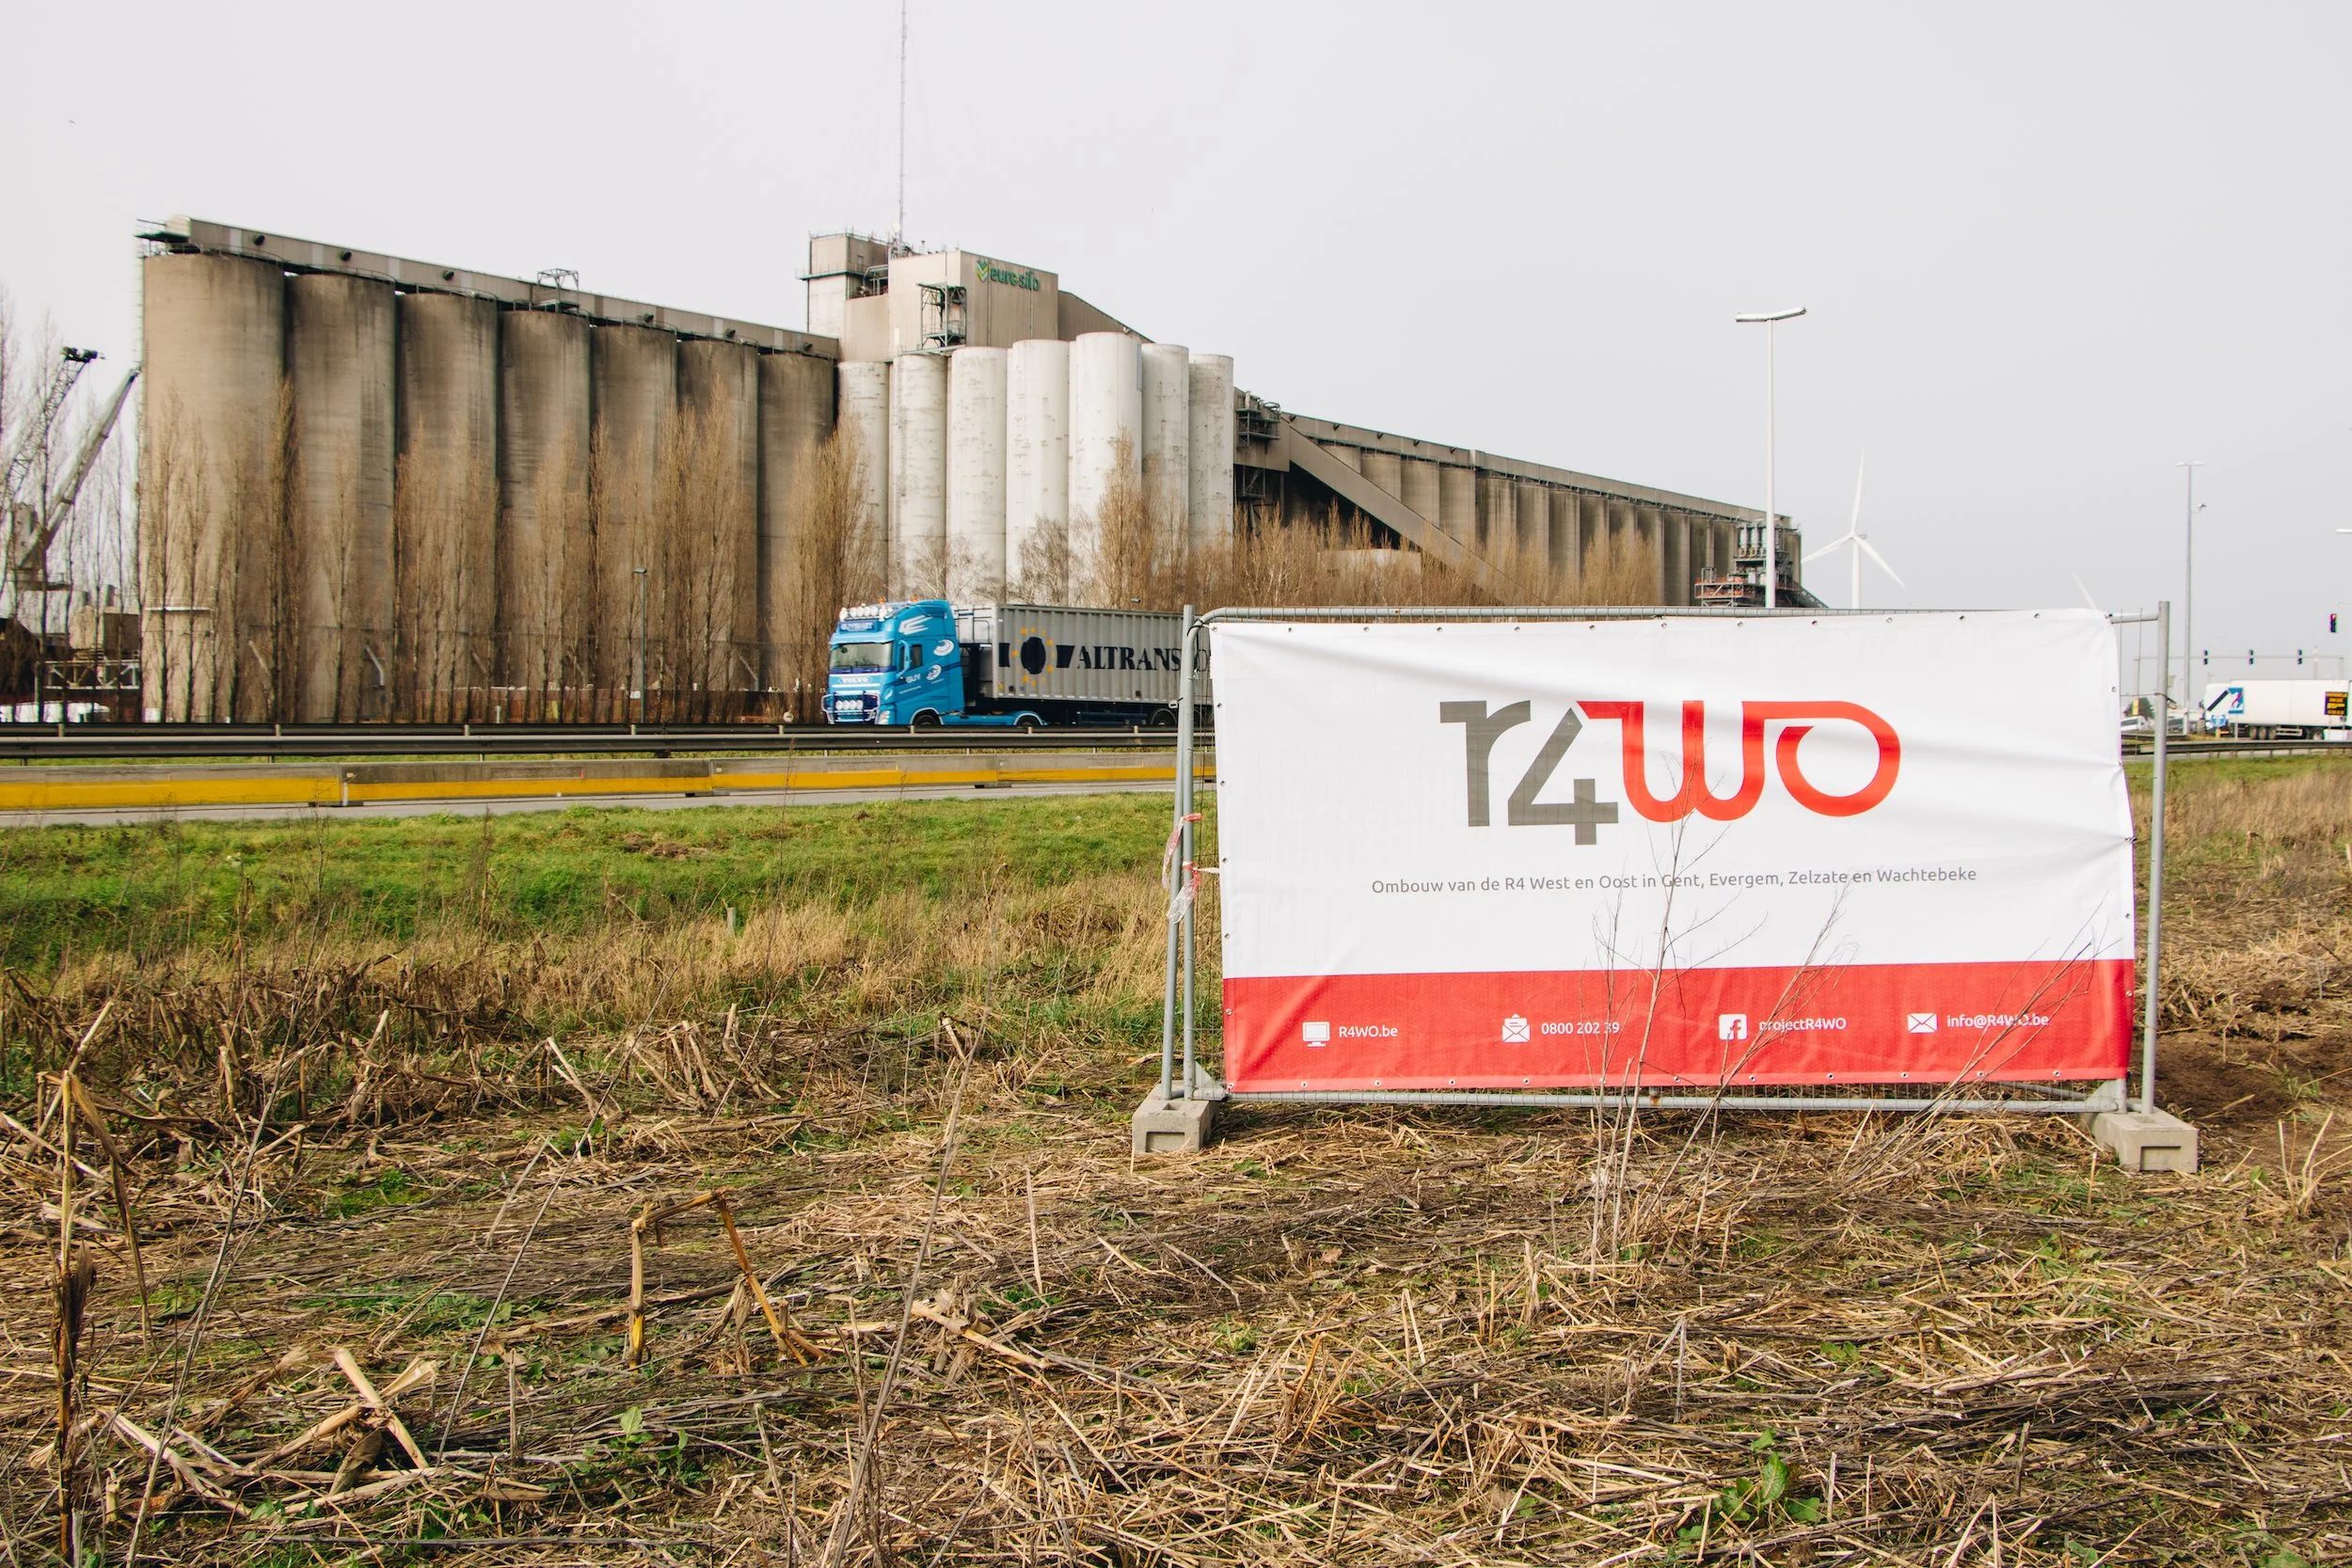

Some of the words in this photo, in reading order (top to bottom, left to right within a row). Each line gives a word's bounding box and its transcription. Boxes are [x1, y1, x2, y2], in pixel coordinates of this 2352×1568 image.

[1372, 879, 1444, 894] Ombouw
[1448, 880, 1475, 892] van
[1481, 877, 1500, 891] de
[1505, 877, 1525, 890] R4
[1530, 877, 1570, 890] West
[1575, 879, 1594, 889] en
[1599, 875, 1638, 889] Oost
[1643, 874, 1658, 888] in
[1661, 874, 1705, 889] Gent,
[1709, 873, 1784, 889] Evergem,
[1788, 870, 1848, 884] Zelzate
[1852, 872, 1872, 883] en
[1876, 866, 1977, 882] Wachtebeke
[1338, 1025, 1398, 1038] R4WO.be
[1541, 1022, 1573, 1036] 0800
[1577, 1022, 1600, 1035] 202
